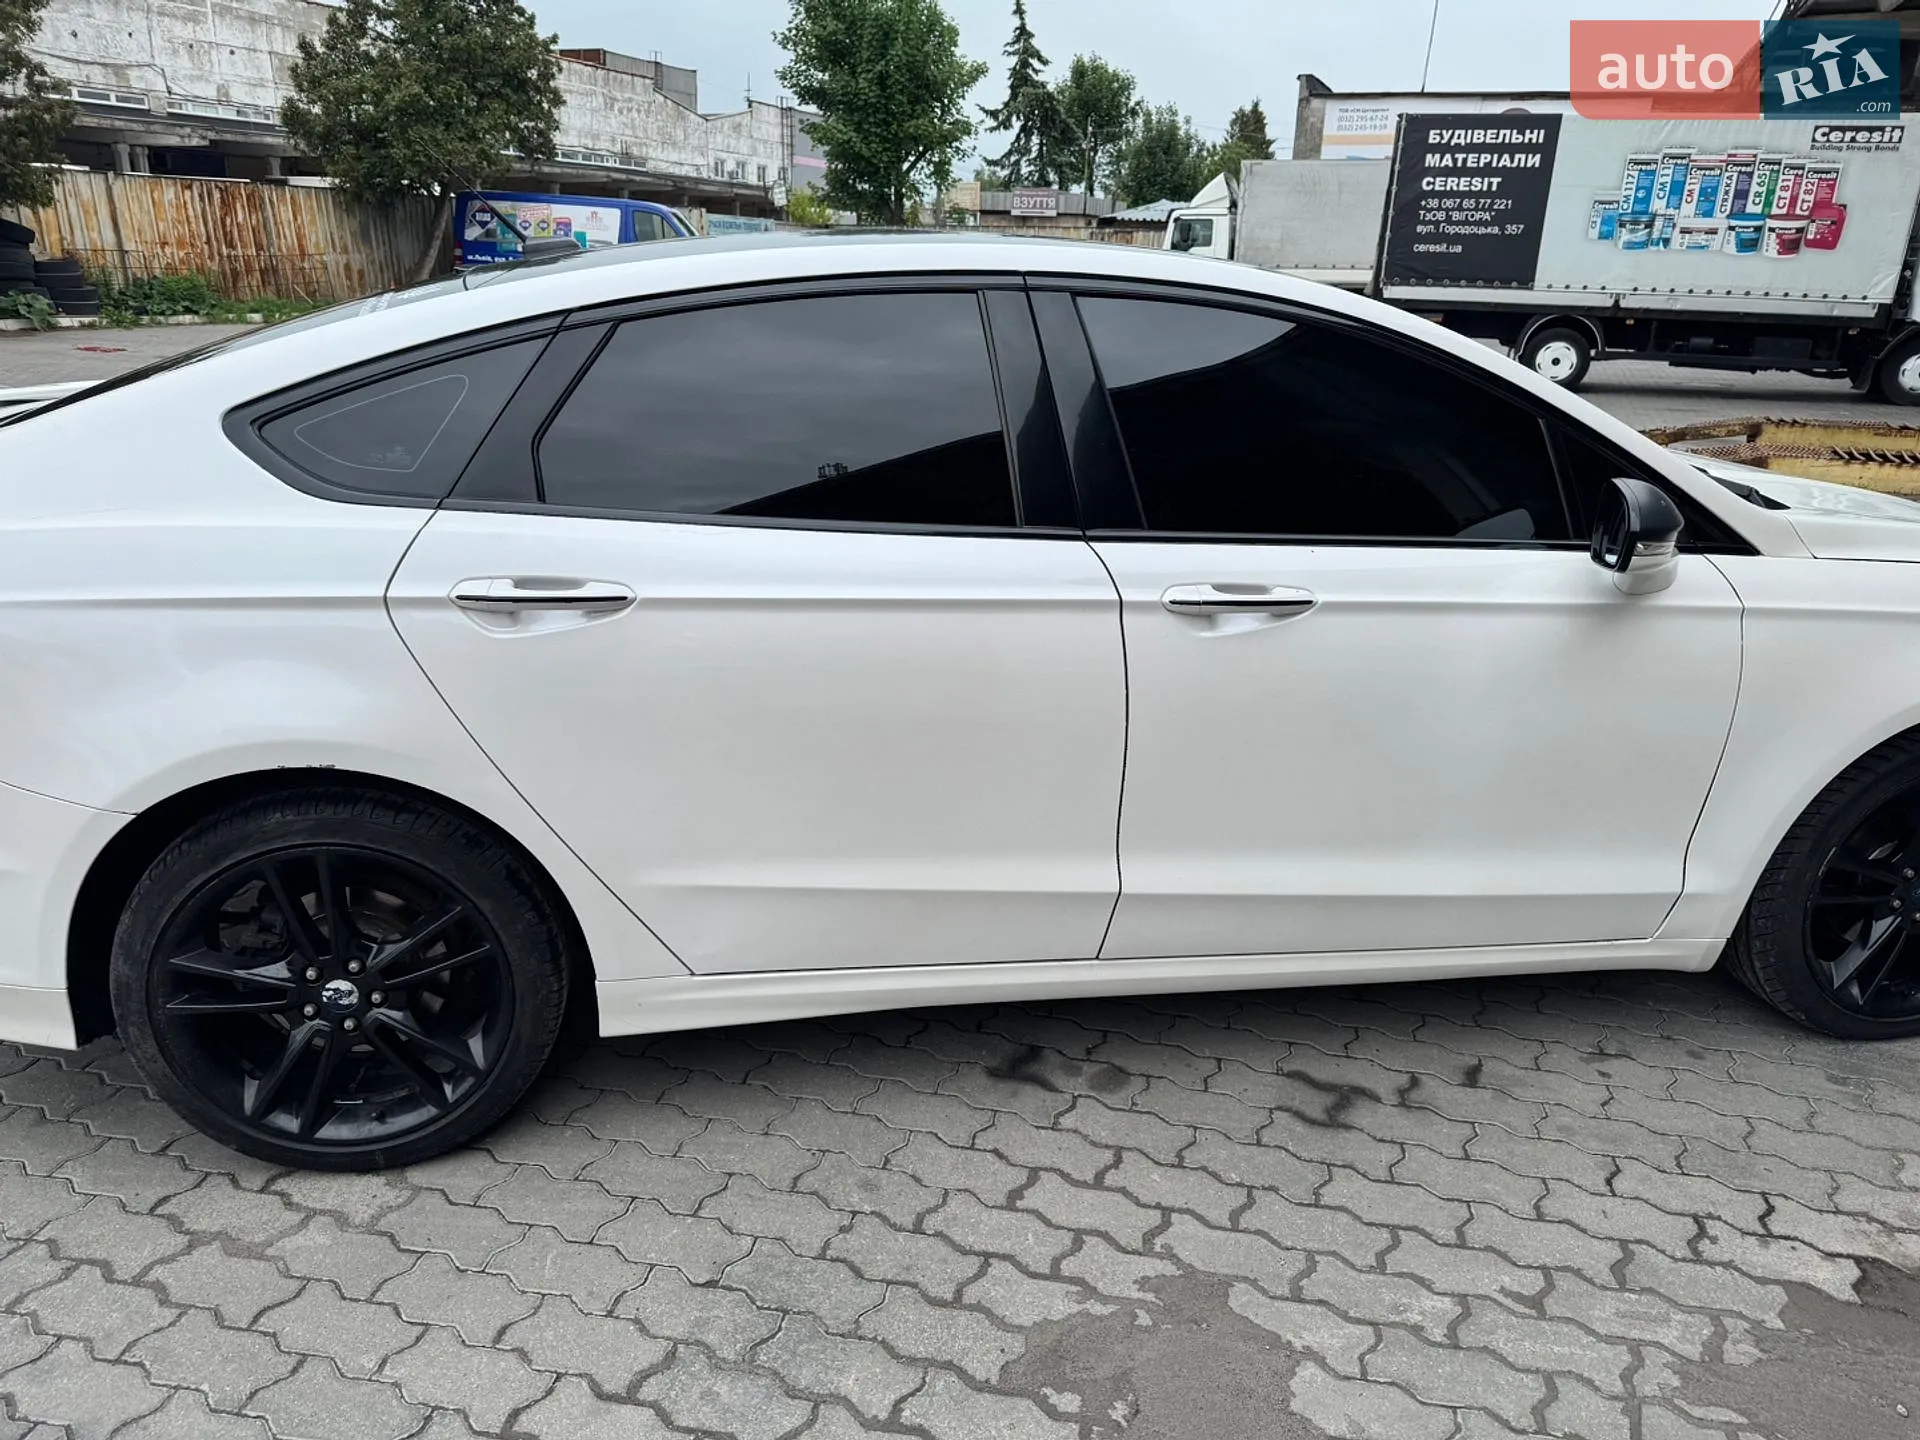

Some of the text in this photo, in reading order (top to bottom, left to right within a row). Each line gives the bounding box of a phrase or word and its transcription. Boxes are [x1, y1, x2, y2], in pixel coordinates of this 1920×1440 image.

[1428, 129, 1545, 146] БУДІВЕЛЬНІ
[1814, 126, 1902, 143] Ceresit
[1810, 144, 1844, 152] Building
[1846, 144, 1873, 152] Strong
[1425, 153, 1541, 168] МАТЕРІАЛИ
[1664, 157, 1689, 165] Ceresi
[1628, 162, 1657, 171] Ceresit
[1691, 168, 1721, 176] Ceresit
[1727, 164, 1754, 172] Ceresi
[1421, 177, 1501, 191] CERESIT
[1719, 174, 1735, 214] СТЯЖКА
[1013, 196, 1056, 209] ВЗУТТЯ
[1420, 199, 1512, 209] +38 067 65 77 221
[1416, 223, 1524, 235] вул. Городоцька, 357
[1413, 243, 1462, 253] ceresit.ua
